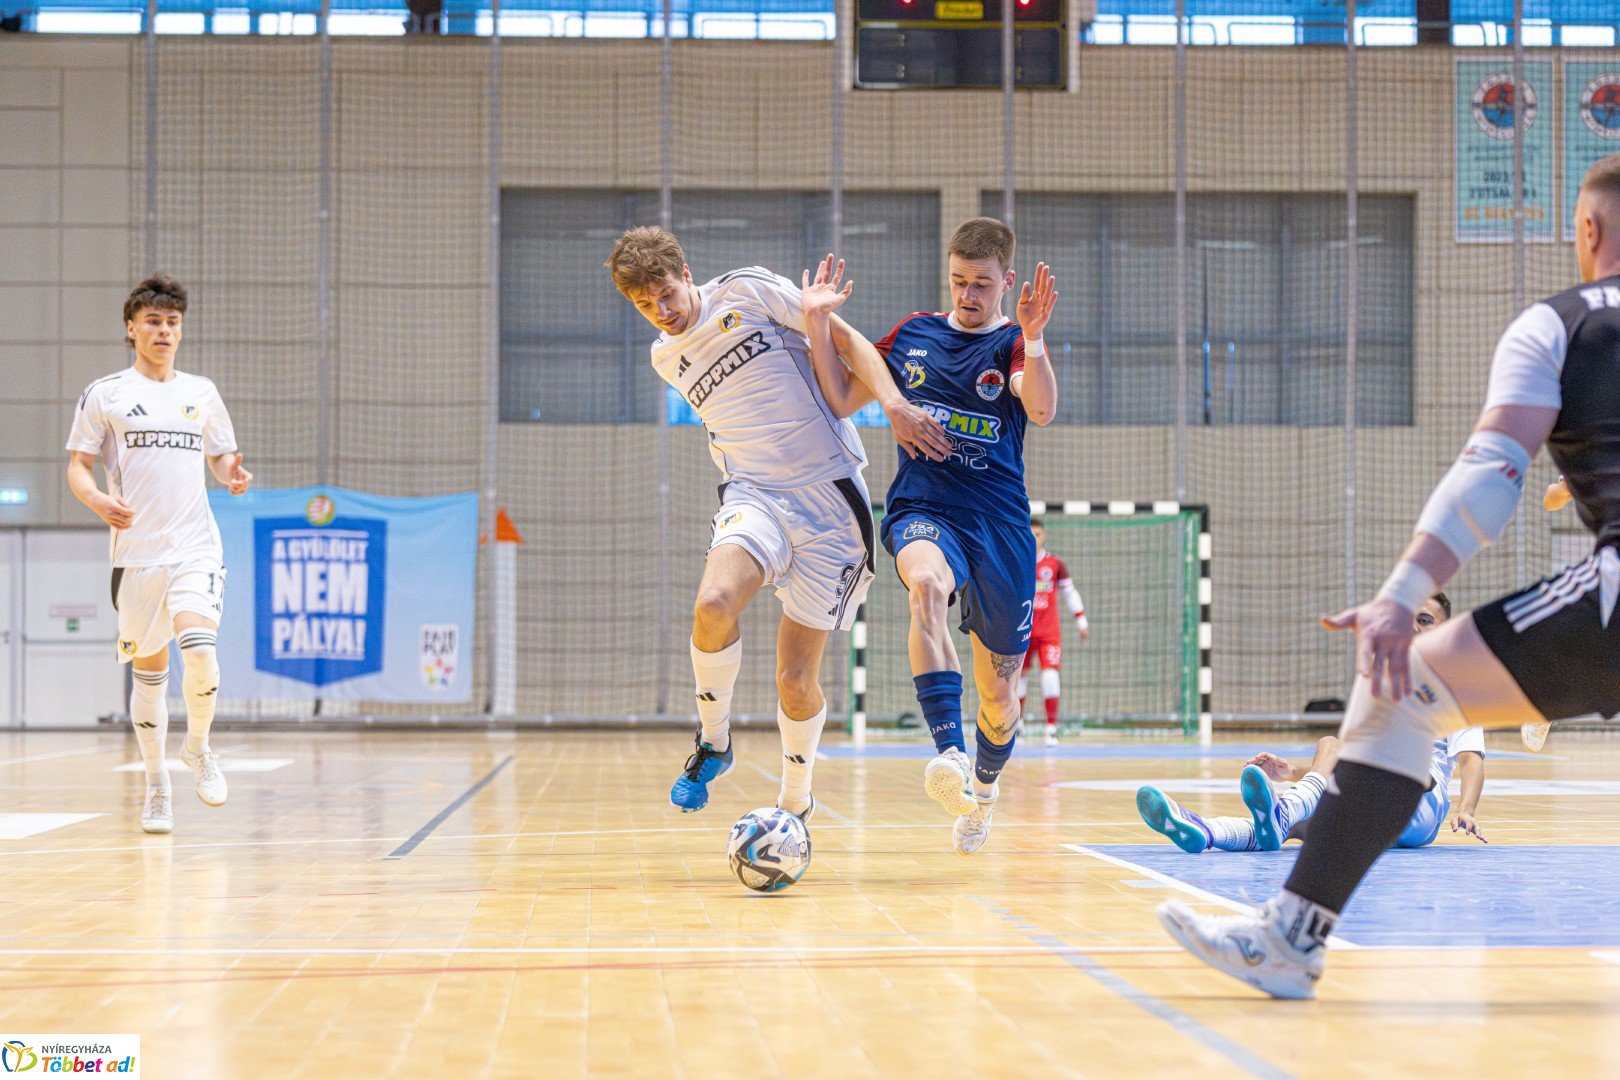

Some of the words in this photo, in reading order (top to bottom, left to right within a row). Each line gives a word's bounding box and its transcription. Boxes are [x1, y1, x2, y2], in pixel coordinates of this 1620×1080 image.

[907, 349, 928, 357] JAKO
[913, 402, 998, 439] PPMIX
[273, 561, 369, 615] NEM
[273, 613, 367, 655] PÁLYA!
[931, 721, 956, 735] JAKO
